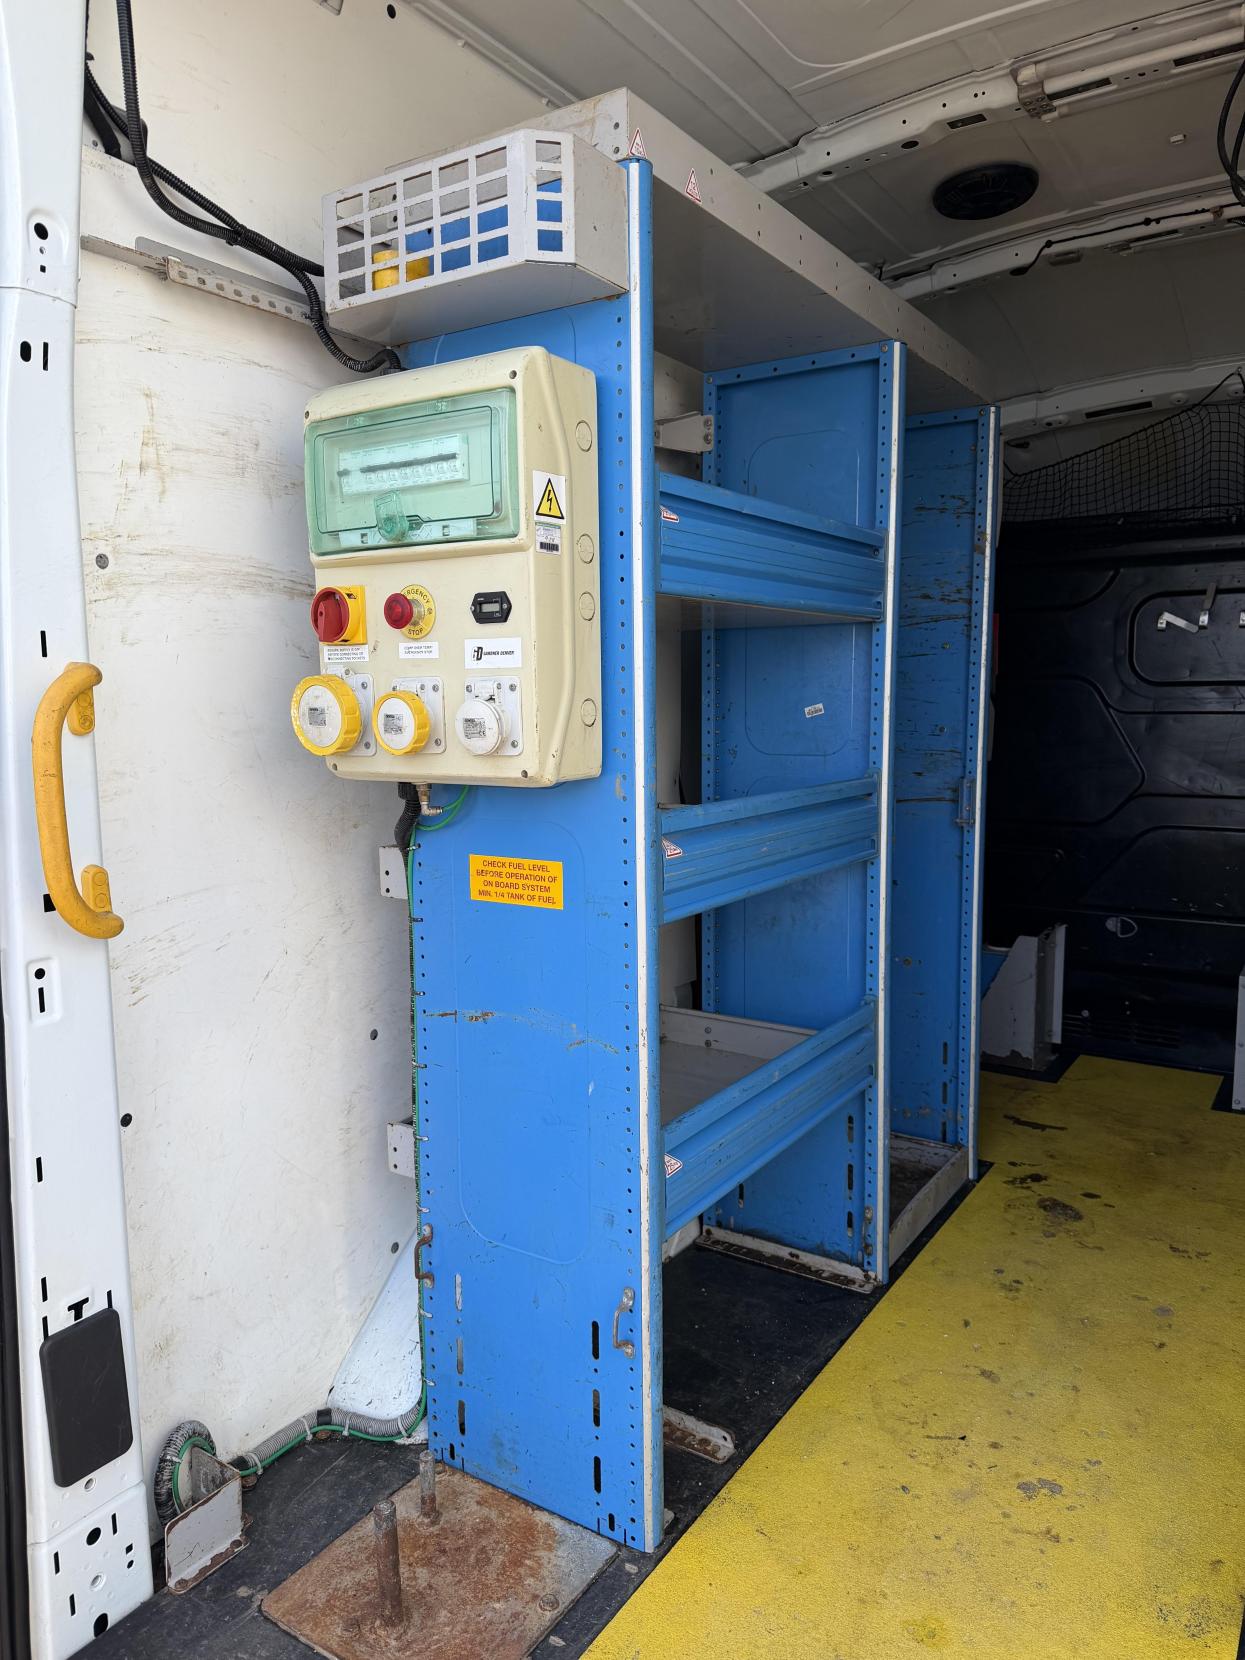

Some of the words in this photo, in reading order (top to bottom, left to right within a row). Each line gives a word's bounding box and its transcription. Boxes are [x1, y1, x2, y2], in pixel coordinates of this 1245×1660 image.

[404, 588, 430, 604] RGENCY
[408, 627, 423, 636] STOP
[482, 860, 507, 869] CHECK
[508, 862, 526, 871] FUEL
[528, 864, 550, 873] LEVEL
[476, 869, 503, 879] BEFORE
[505, 871, 546, 882] OPERATION
[547, 875, 558, 883] OF
[494, 881, 520, 890] BOARD
[521, 883, 551, 893] SYSTEM
[478, 889, 492, 897] MIN.
[507, 892, 525, 901] TANK
[526, 894, 537, 902] OF
[538, 895, 557, 904] FUEL
